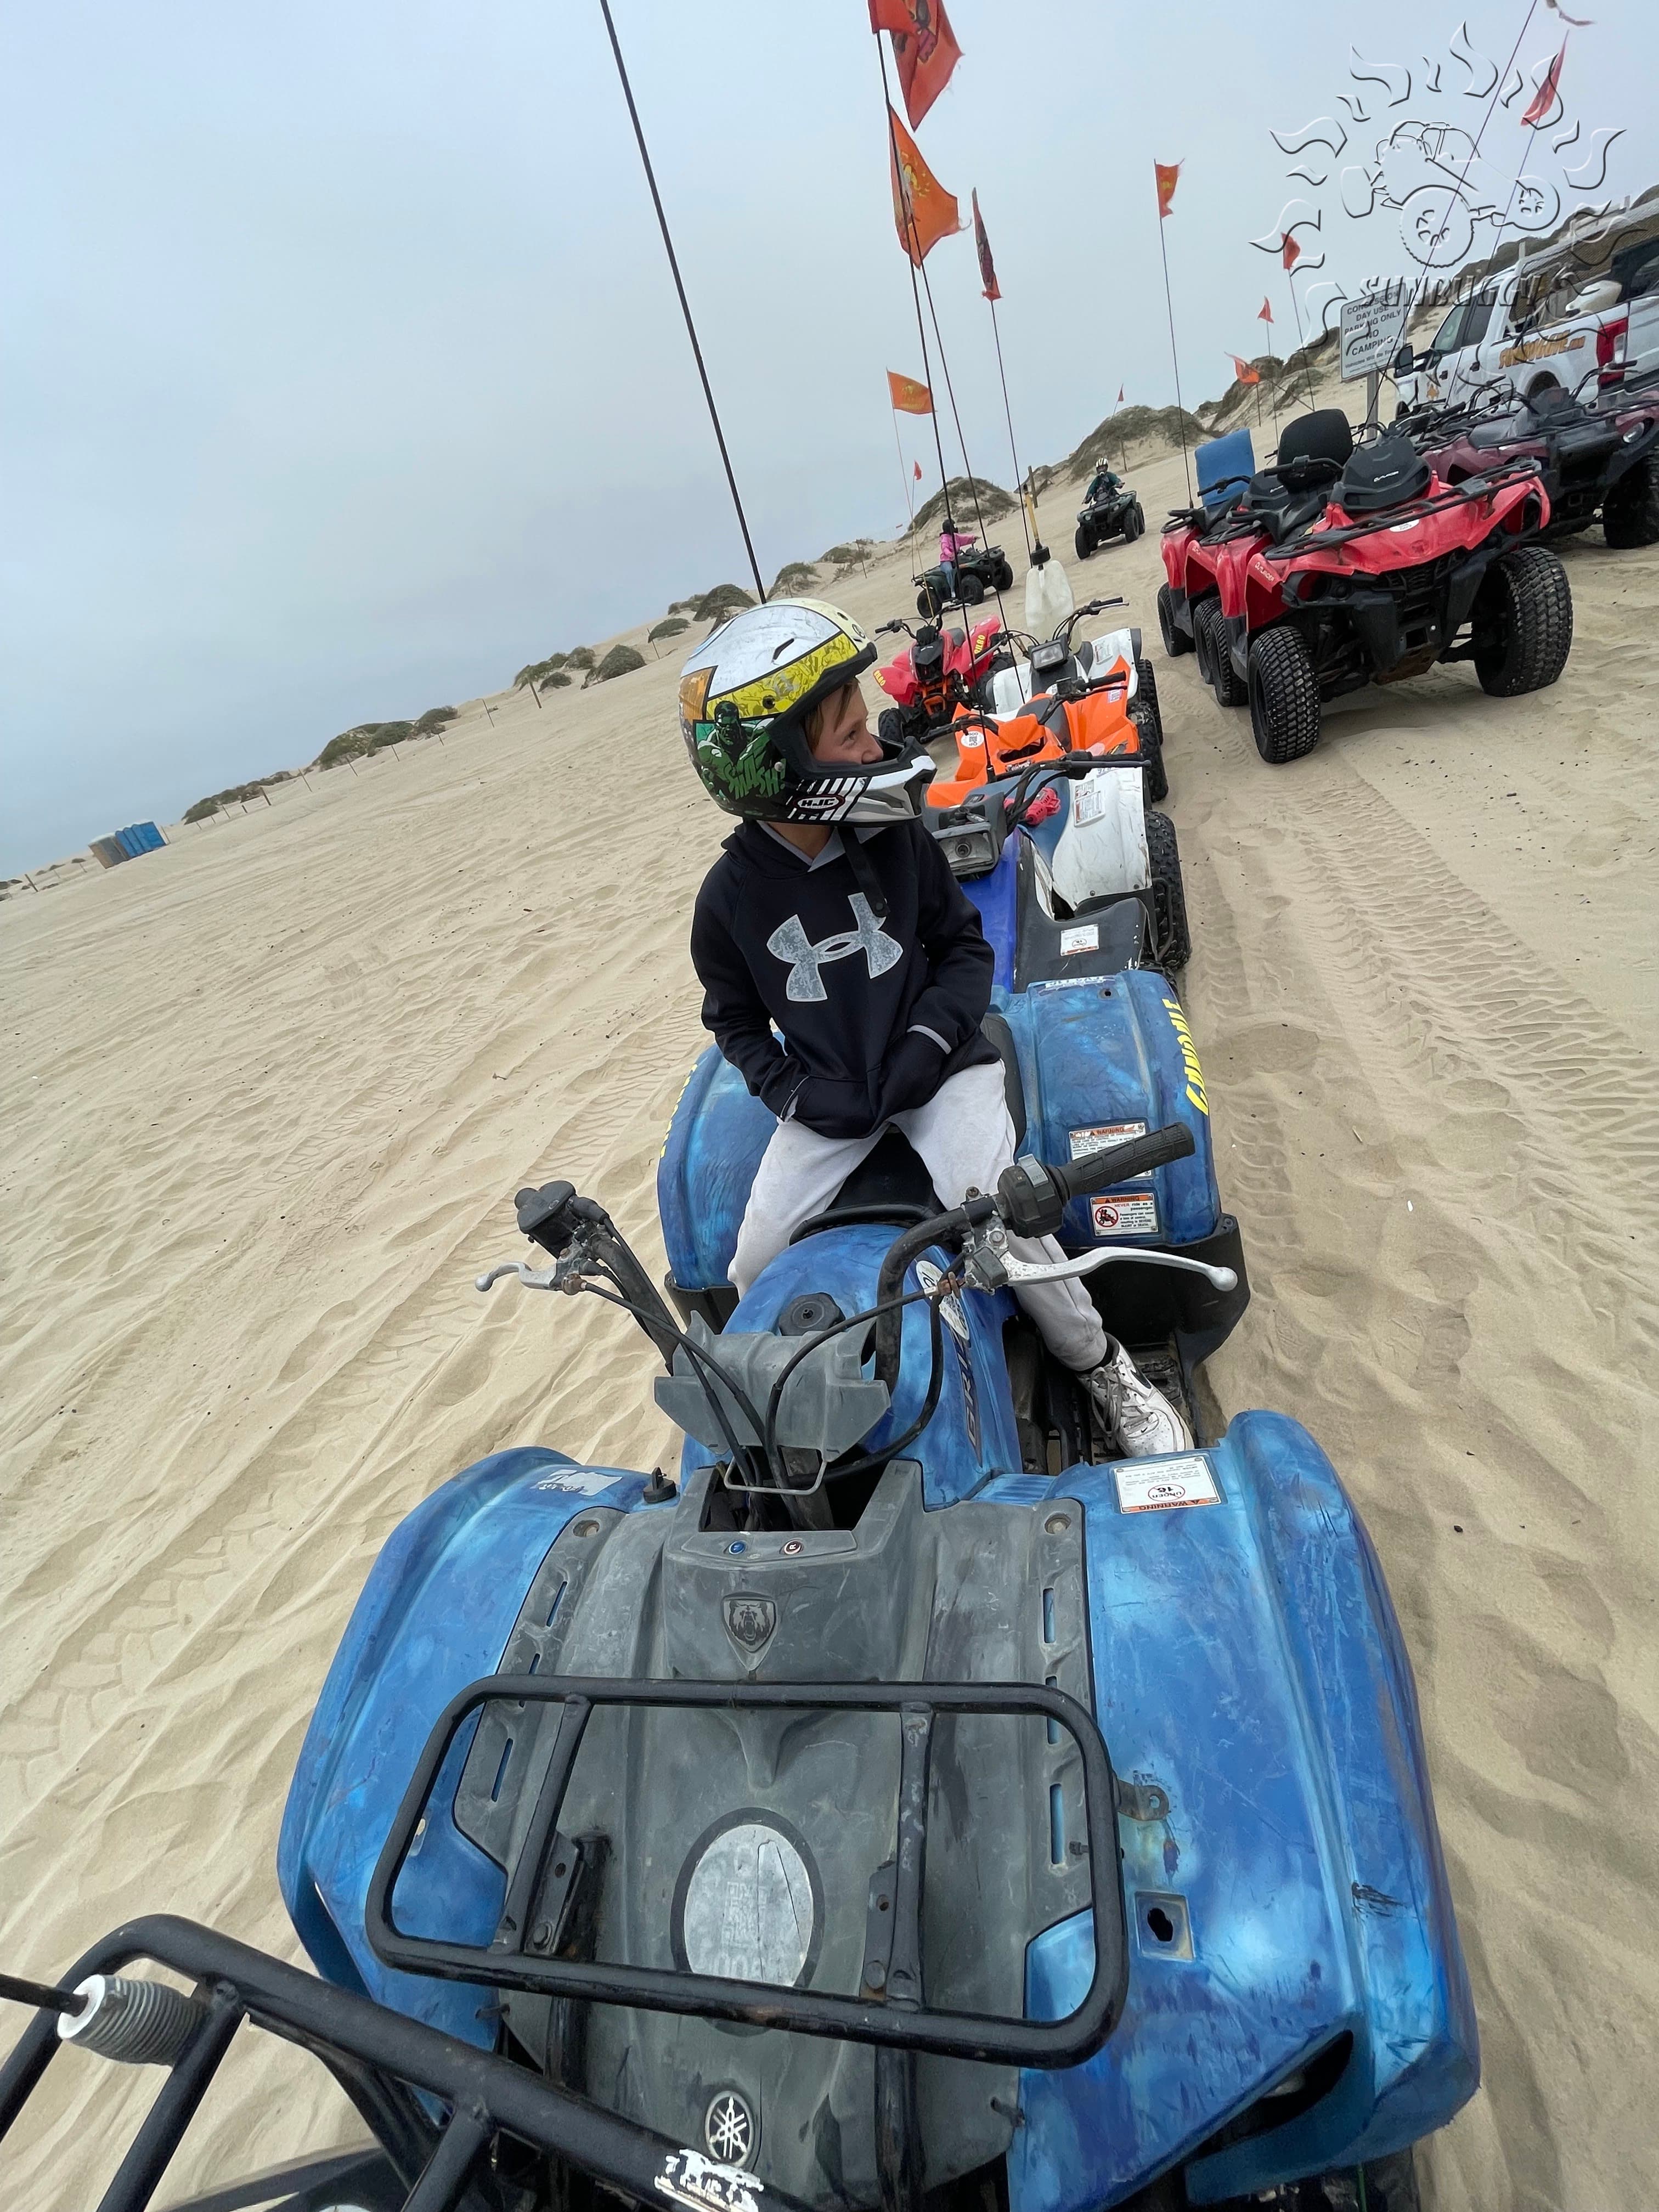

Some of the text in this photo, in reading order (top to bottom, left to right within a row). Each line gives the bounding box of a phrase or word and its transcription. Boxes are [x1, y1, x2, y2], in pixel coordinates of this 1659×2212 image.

[1347, 291, 1400, 314] CONCSSON
[1356, 306, 1389, 321] DAY USE
[1345, 309, 1401, 335] PARKNG ONLY
[1352, 335, 1393, 356] CAMPING
[973, 634, 986, 654] BILBO
[873, 670, 886, 686] BILBO
[800, 799, 835, 807] HJC
[1097, 1126, 1125, 1135] WARNING
[1139, 1501, 1188, 1510] WARNING
